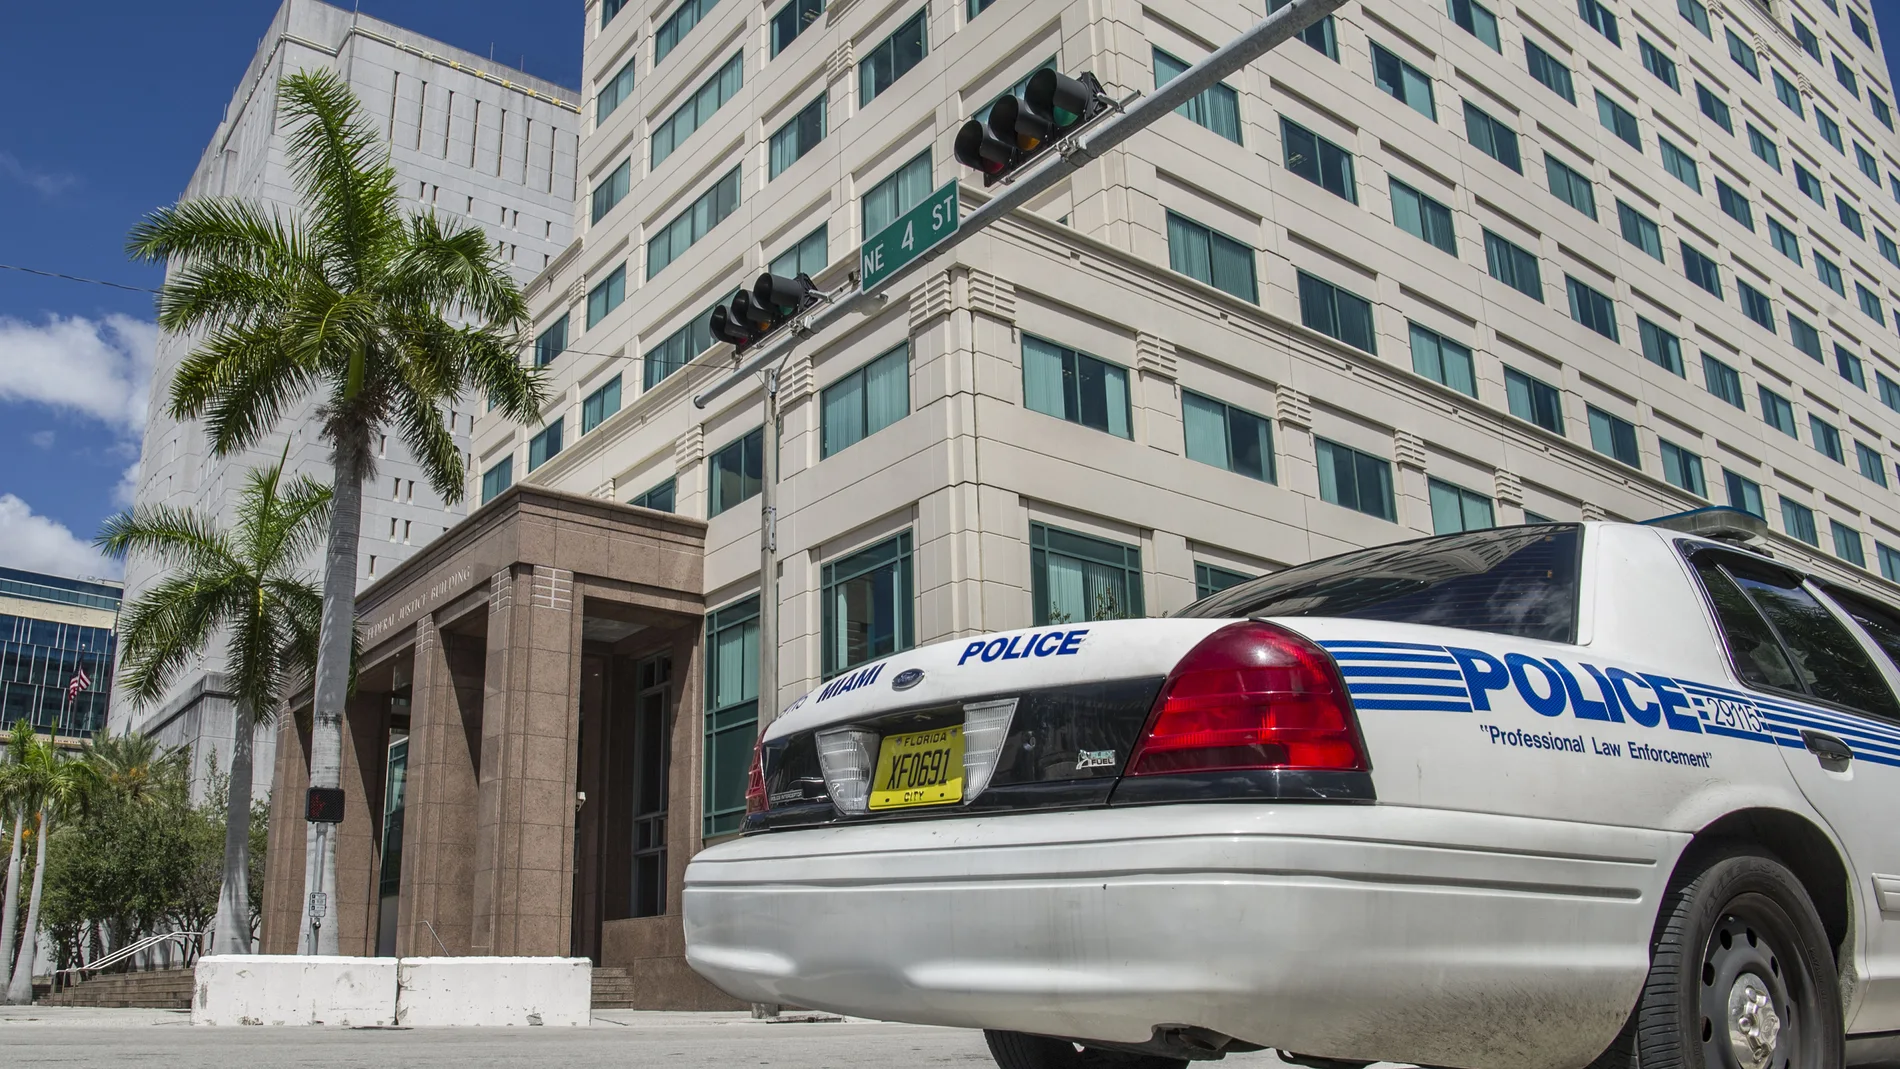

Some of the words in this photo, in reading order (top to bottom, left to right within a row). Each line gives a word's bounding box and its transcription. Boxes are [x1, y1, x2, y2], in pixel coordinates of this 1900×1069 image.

[864, 243, 885, 279] NE
[901, 220, 914, 251] 4
[932, 195, 954, 231] ST
[367, 613, 395, 641] FEDERAL
[397, 592, 428, 621] JUSTICE
[430, 565, 471, 600] BUILDING
[957, 629, 1090, 666] POLICE
[816, 663, 887, 703] MIAMI
[1442, 646, 1703, 734] POLICE
[1707, 697, 1763, 733] 29115
[904, 731, 948, 747] FLORIDA
[1090, 751, 1113, 760] FLEX
[1591, 736, 1621, 758] Law
[886, 748, 952, 790] XF0691
[904, 791, 925, 803] CITY
